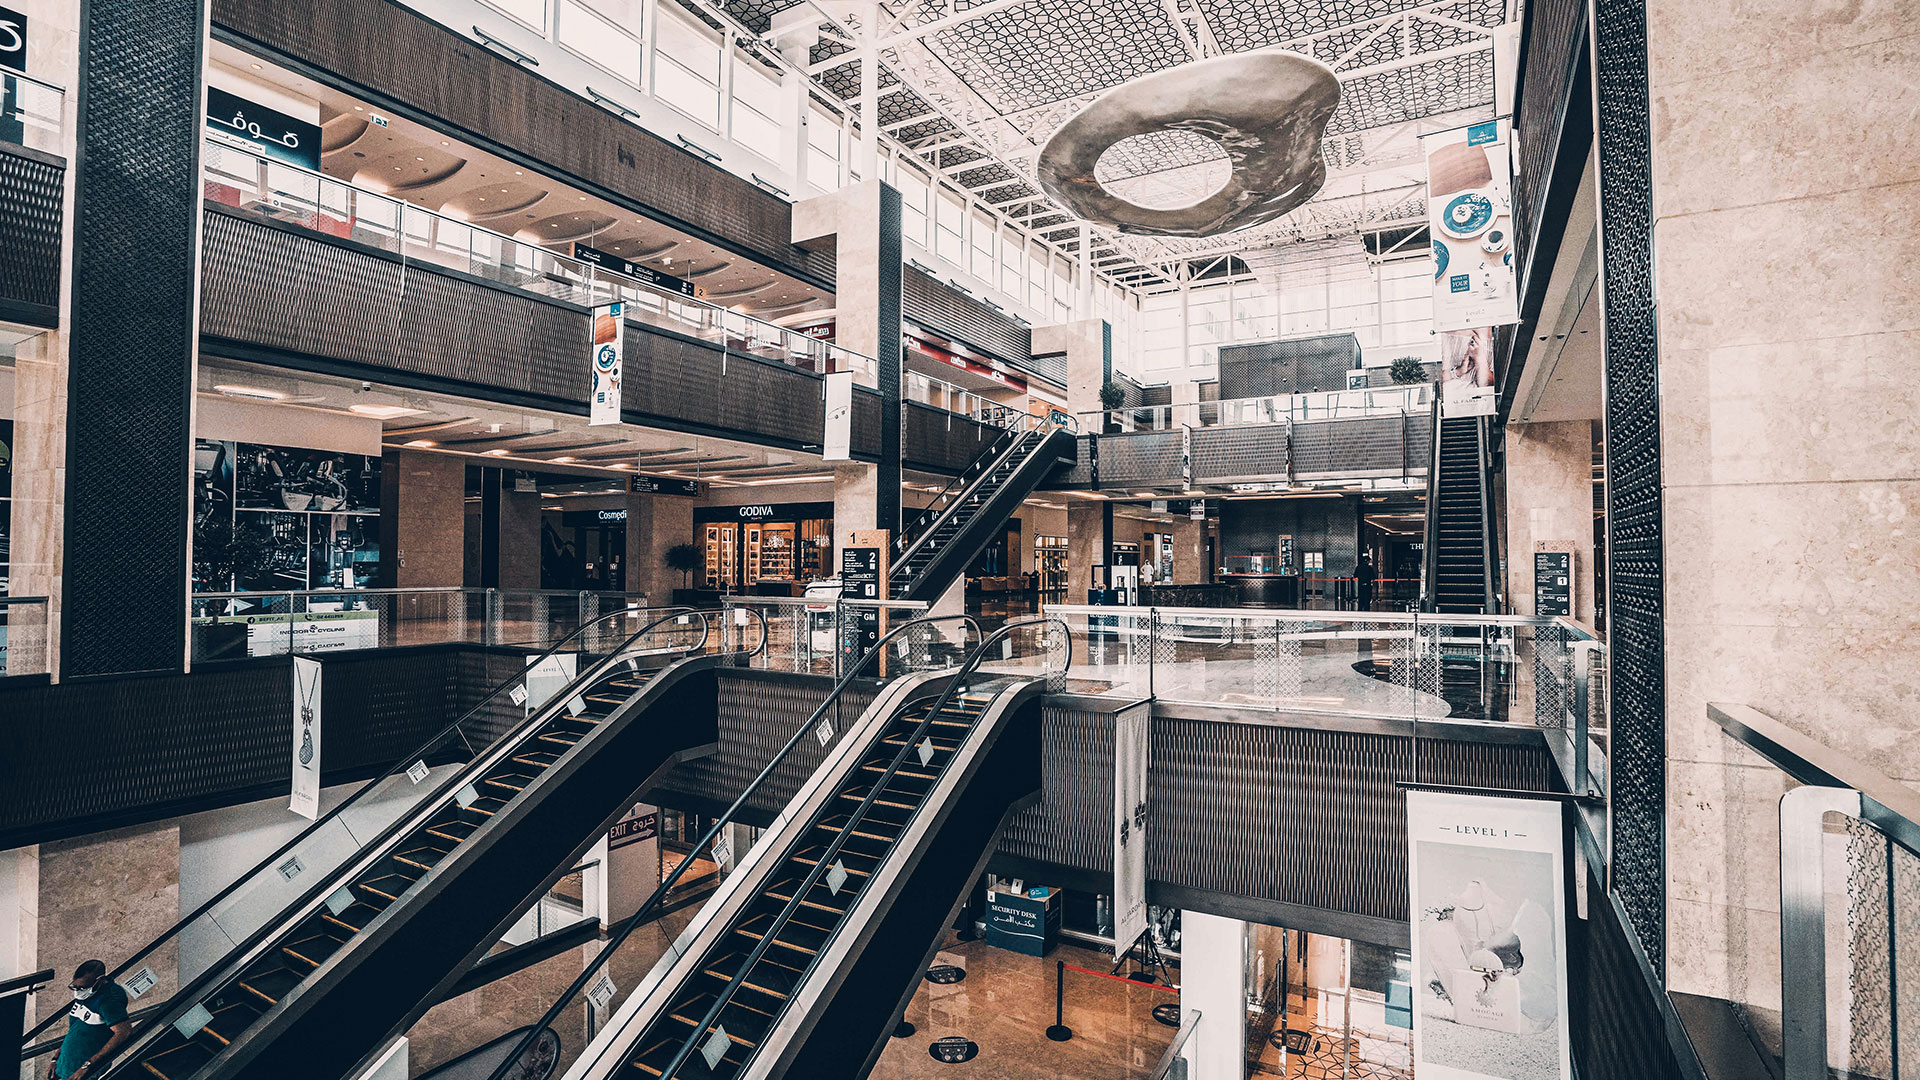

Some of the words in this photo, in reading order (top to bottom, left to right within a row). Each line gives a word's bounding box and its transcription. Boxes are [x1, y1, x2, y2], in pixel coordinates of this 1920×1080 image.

[698, 288, 704, 296] 2
[739, 505, 774, 517] GODIVA
[850, 532, 856, 544] 1
[869, 552, 876, 563] 2
[1561, 555, 1568, 563] 2
[864, 613, 876, 621] GM
[633, 815, 655, 832] خروج
[610, 822, 627, 839] EXIT
[1456, 825, 1497, 837] LEVEL
[991, 904, 1021, 916] SECURITY
[1021, 911, 1037, 920] DESK
